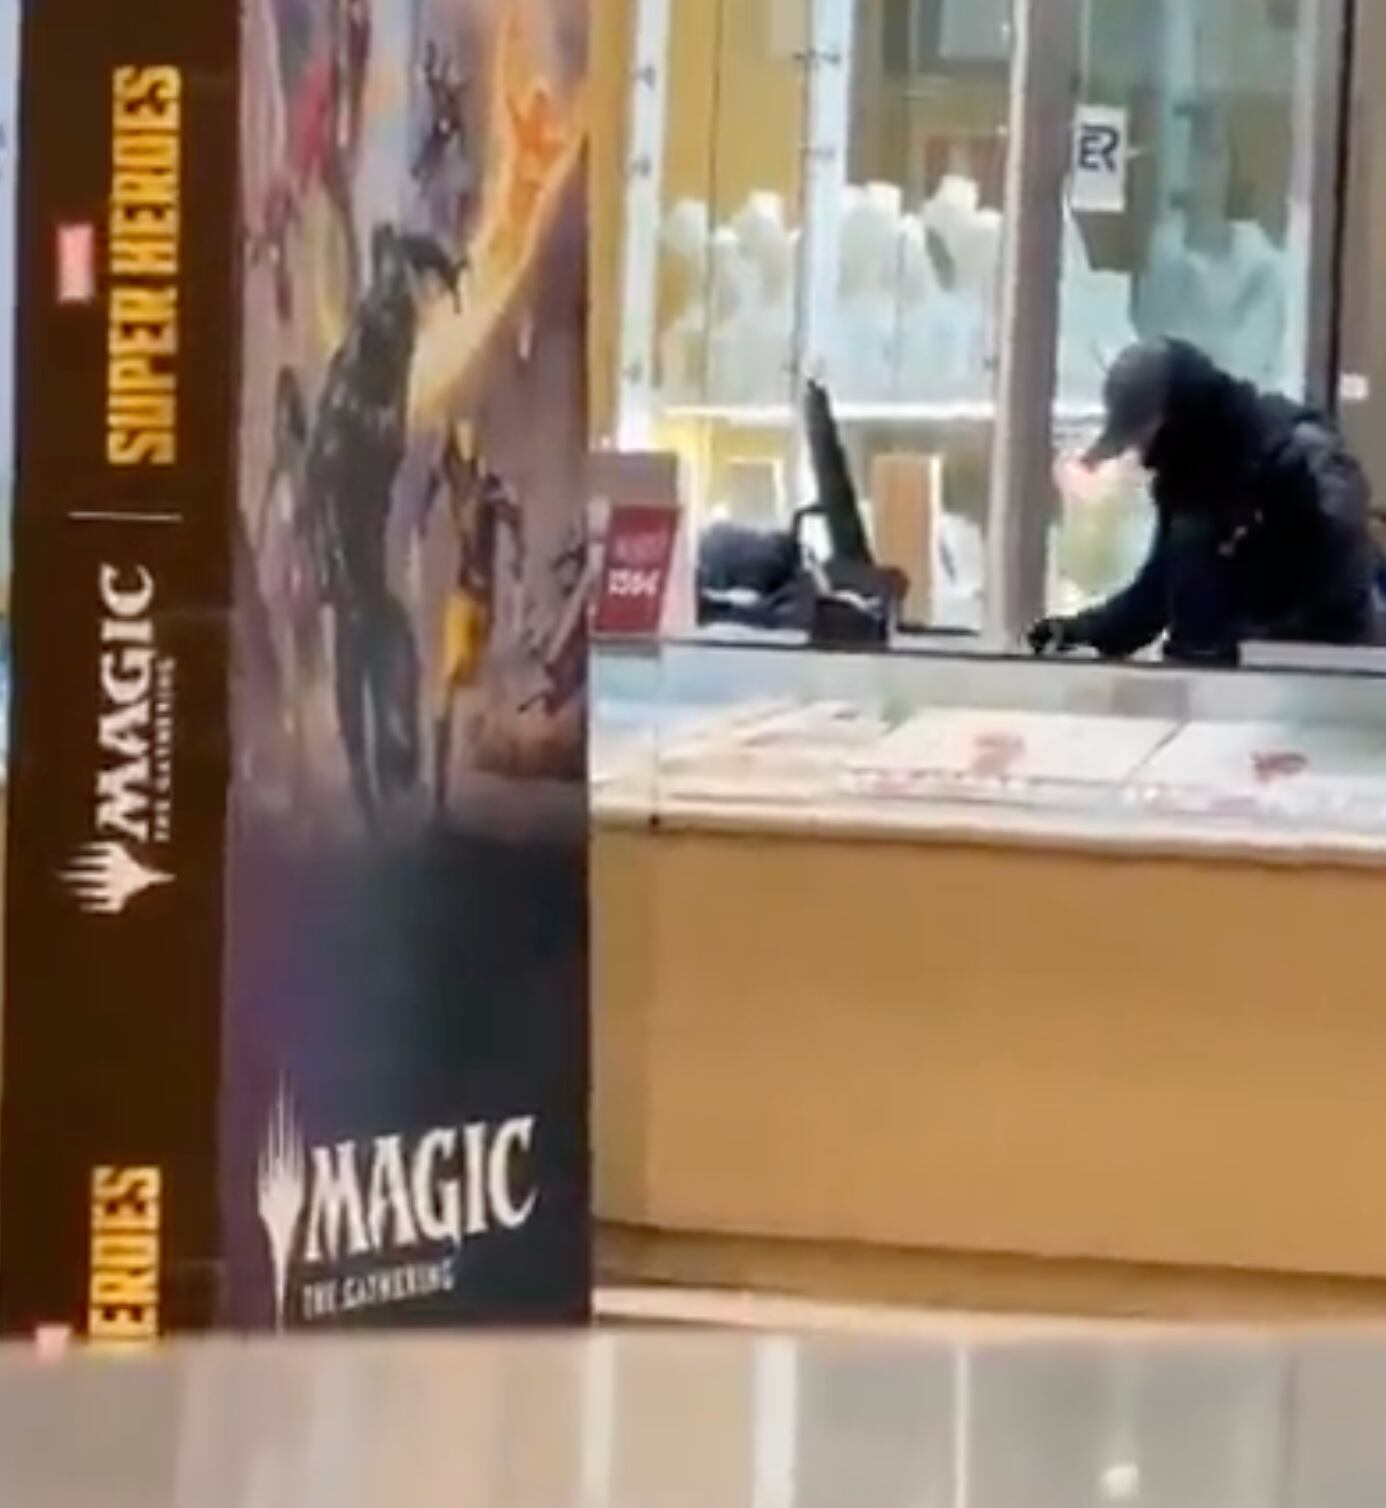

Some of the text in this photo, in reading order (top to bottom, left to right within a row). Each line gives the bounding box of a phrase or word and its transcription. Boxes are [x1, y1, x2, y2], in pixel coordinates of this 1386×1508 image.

[107, 65, 181, 464] SUPER HEROES
[95, 562, 155, 843] MAGIC
[303, 1115, 538, 1263] MAGIC
